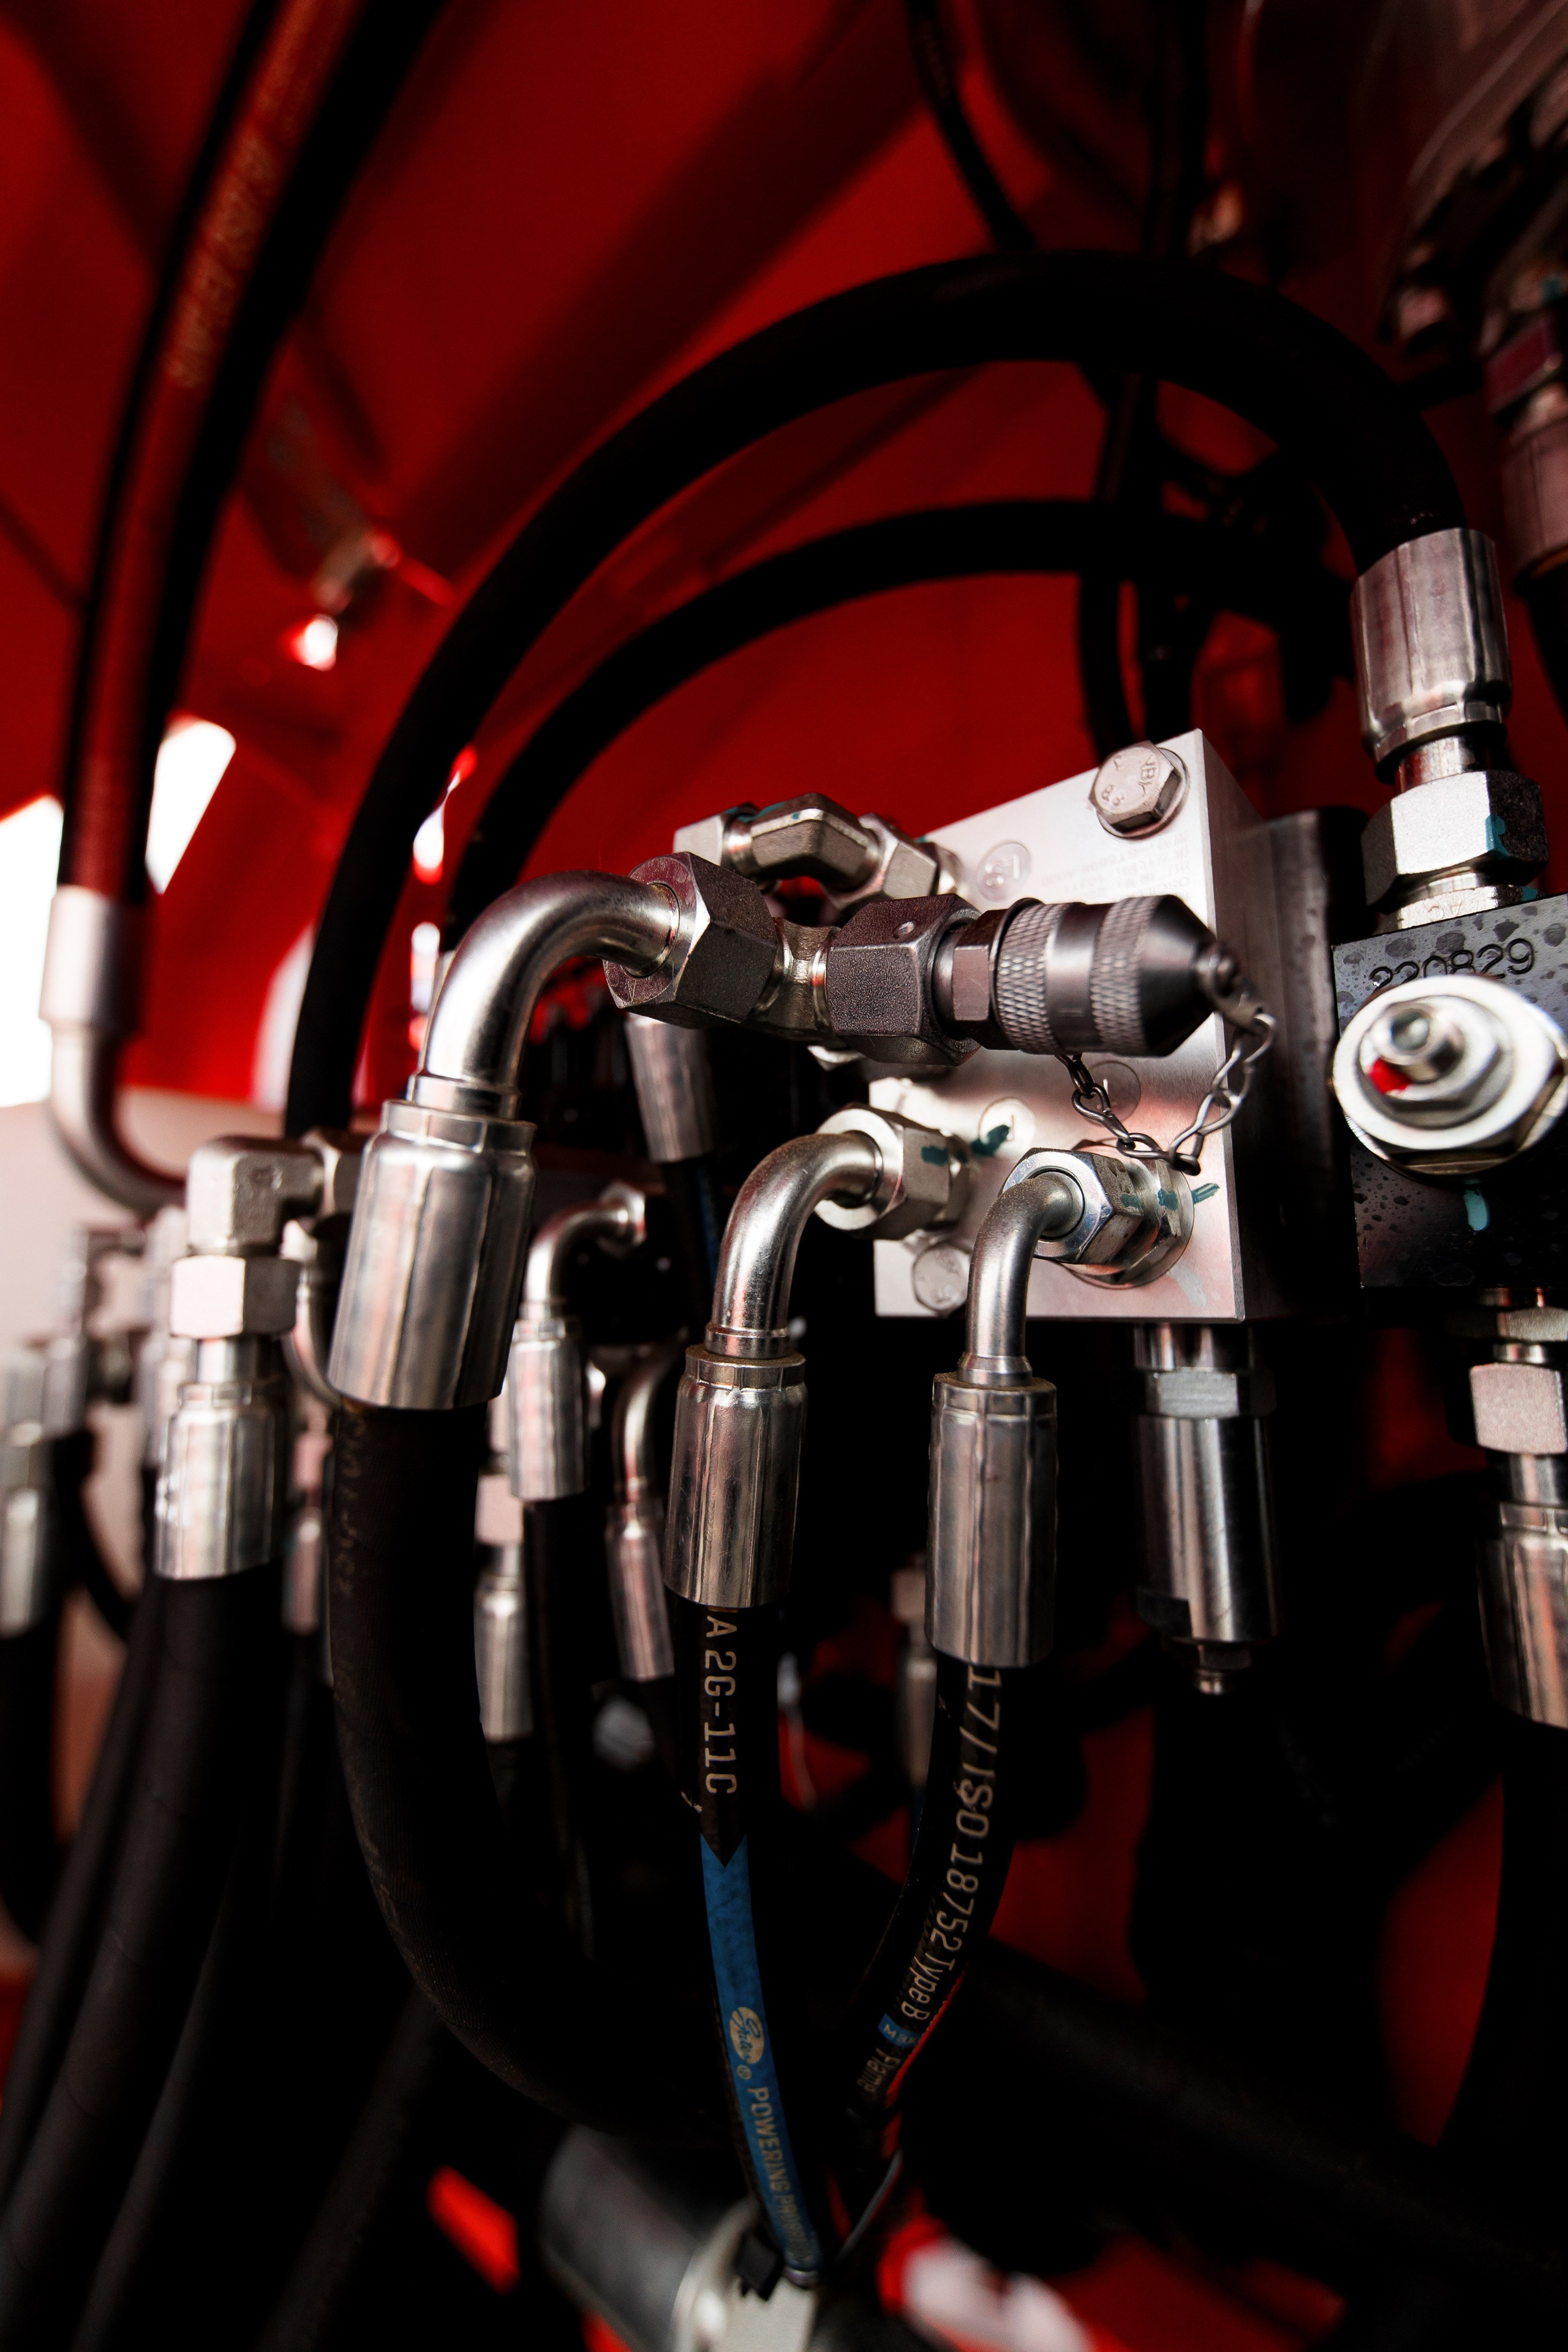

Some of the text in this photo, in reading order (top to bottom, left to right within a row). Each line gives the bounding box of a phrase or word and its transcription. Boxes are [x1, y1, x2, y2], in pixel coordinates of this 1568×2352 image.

[1368, 938, 1534, 995] 220829
[704, 1607, 738, 1795] A 2G-11C
[930, 1842, 984, 1952] 18752
[746, 2086, 791, 2193] POWERING
